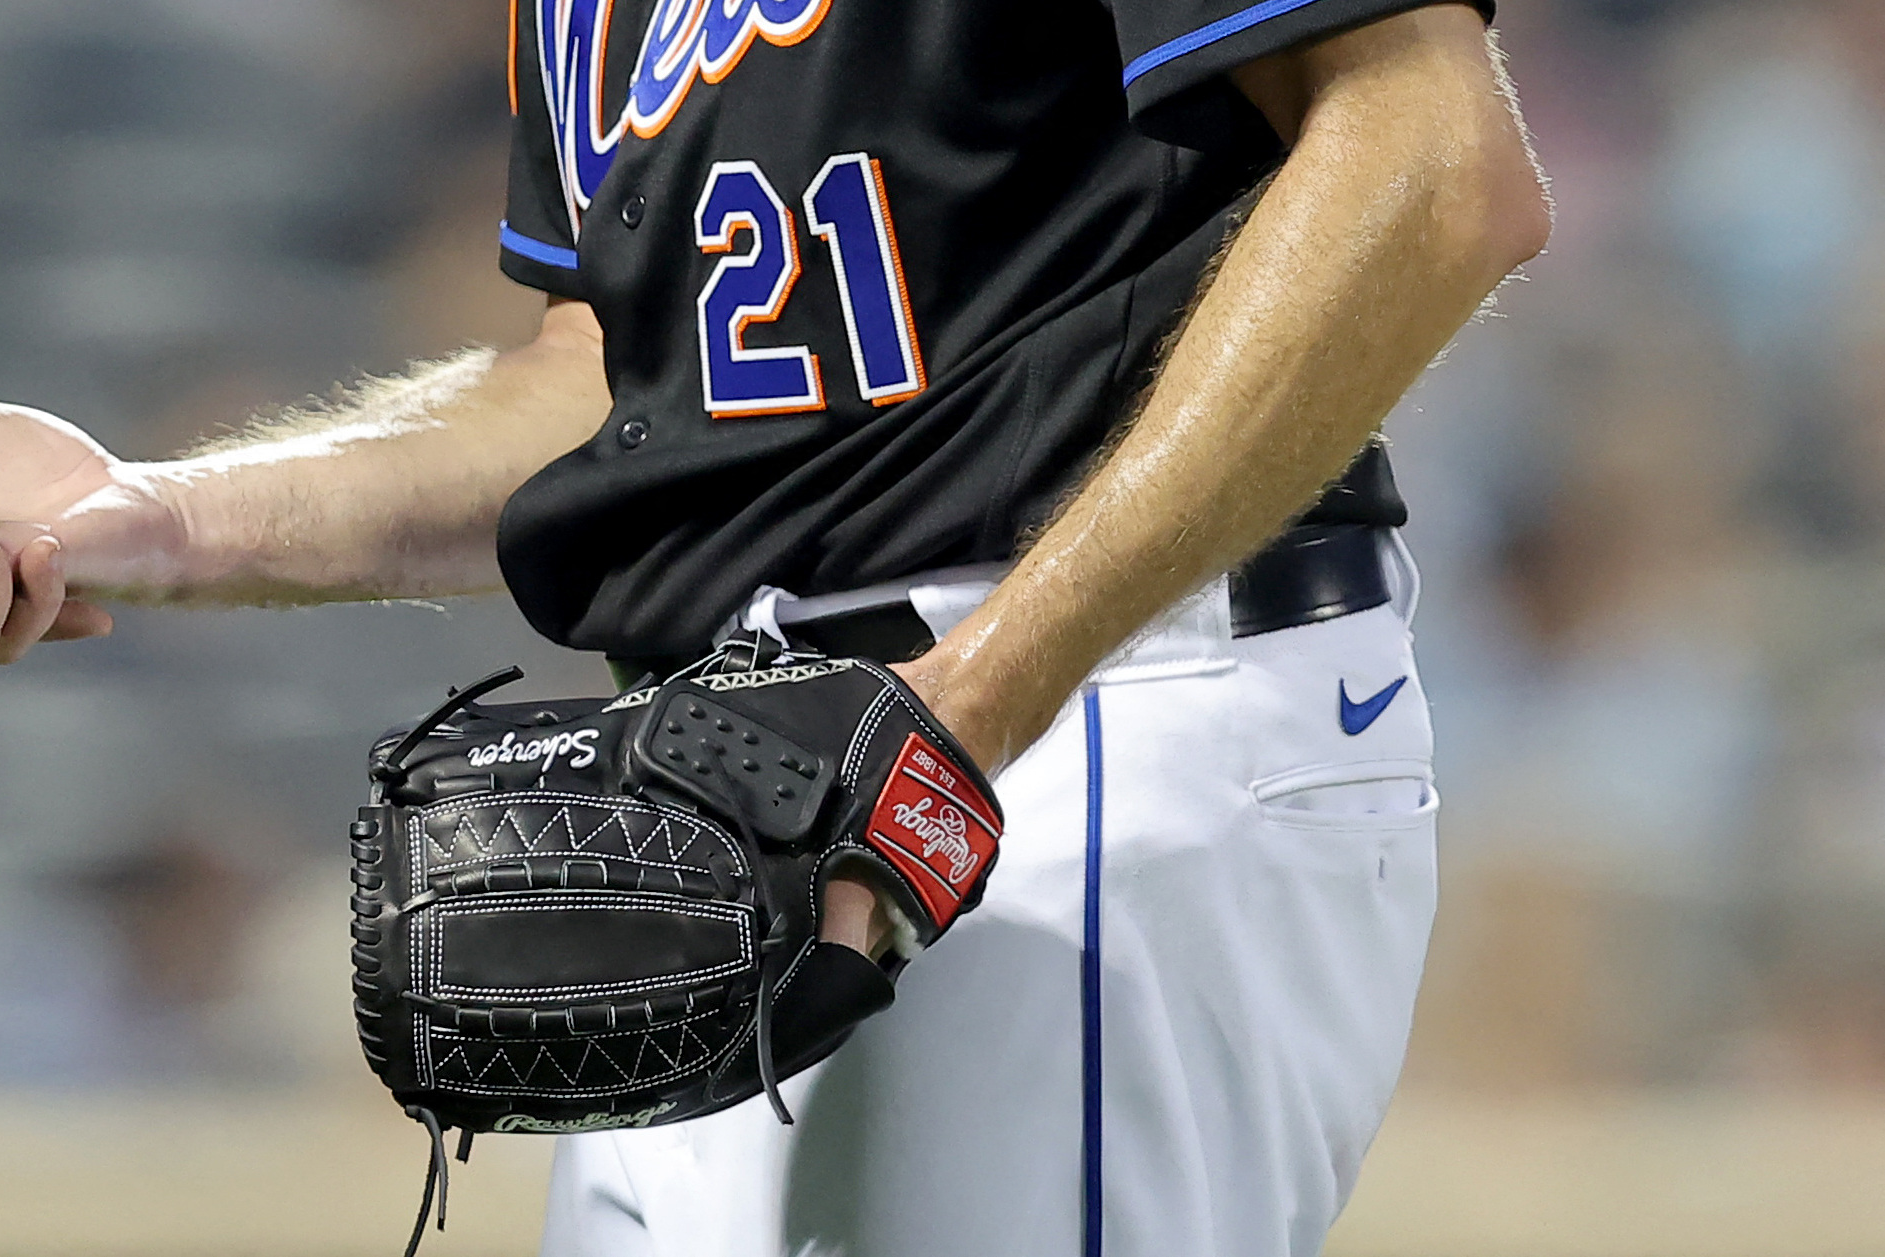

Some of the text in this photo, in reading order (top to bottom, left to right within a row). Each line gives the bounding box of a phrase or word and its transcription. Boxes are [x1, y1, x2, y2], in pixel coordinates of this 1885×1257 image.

[693, 152, 927, 420] 21
[467, 728, 600, 773] Scherzer
[912, 749, 936, 775] 1887
[892, 797, 979, 884] Rawlings
[494, 1101, 678, 1133] Rawlings
